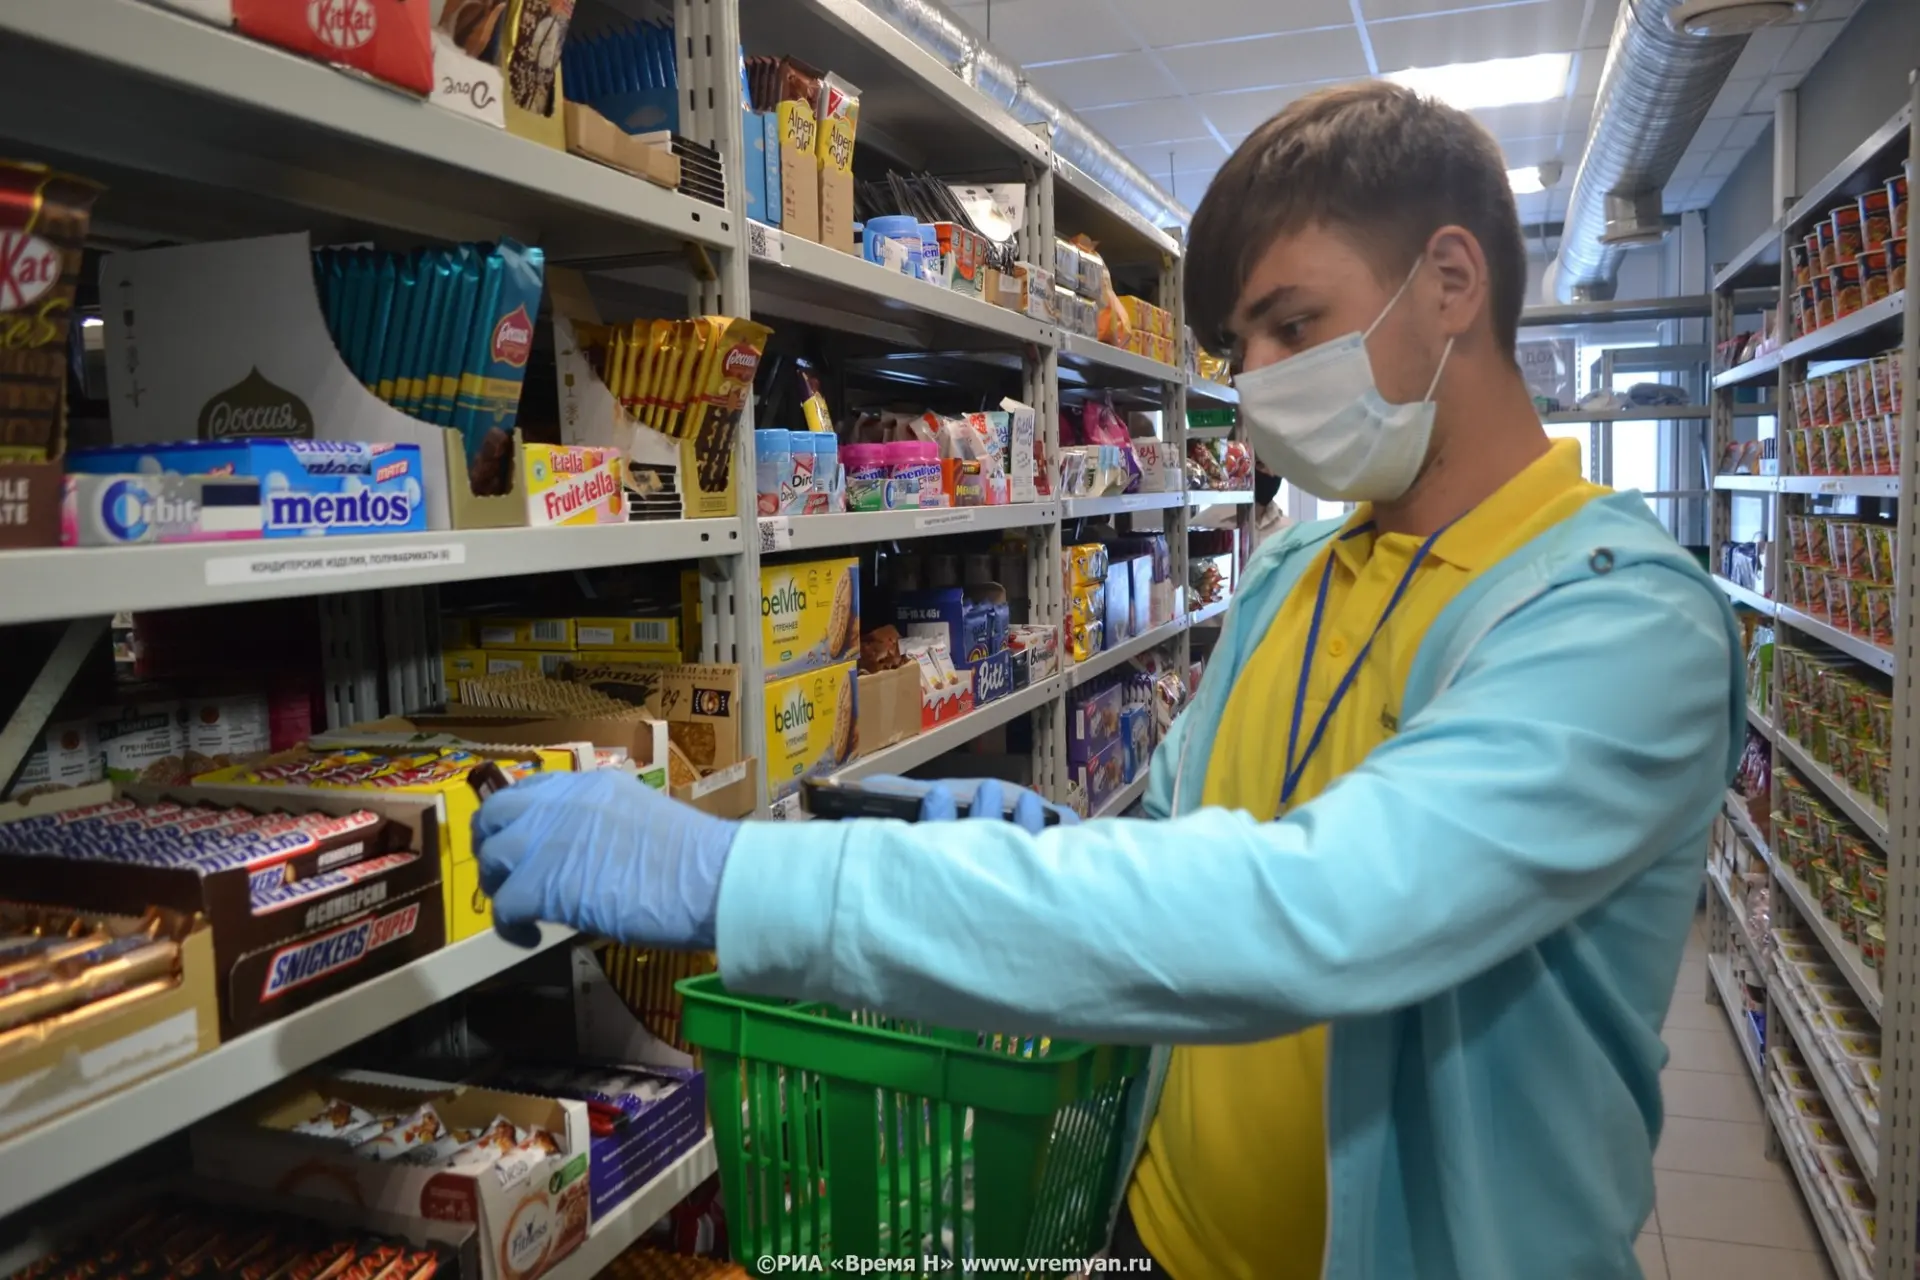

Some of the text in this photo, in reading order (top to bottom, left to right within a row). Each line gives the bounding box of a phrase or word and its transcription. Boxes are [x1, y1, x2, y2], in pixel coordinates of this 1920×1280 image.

[788, 106, 814, 137] Alpen
[830, 123, 852, 150] Alpen
[101, 479, 200, 542] Orbit
[271, 488, 410, 525] mentos
[544, 471, 614, 521] Fruit-tella
[761, 576, 807, 617] belVita
[773, 688, 815, 734] belVita
[269, 906, 417, 990] SNICKERS SUPER
